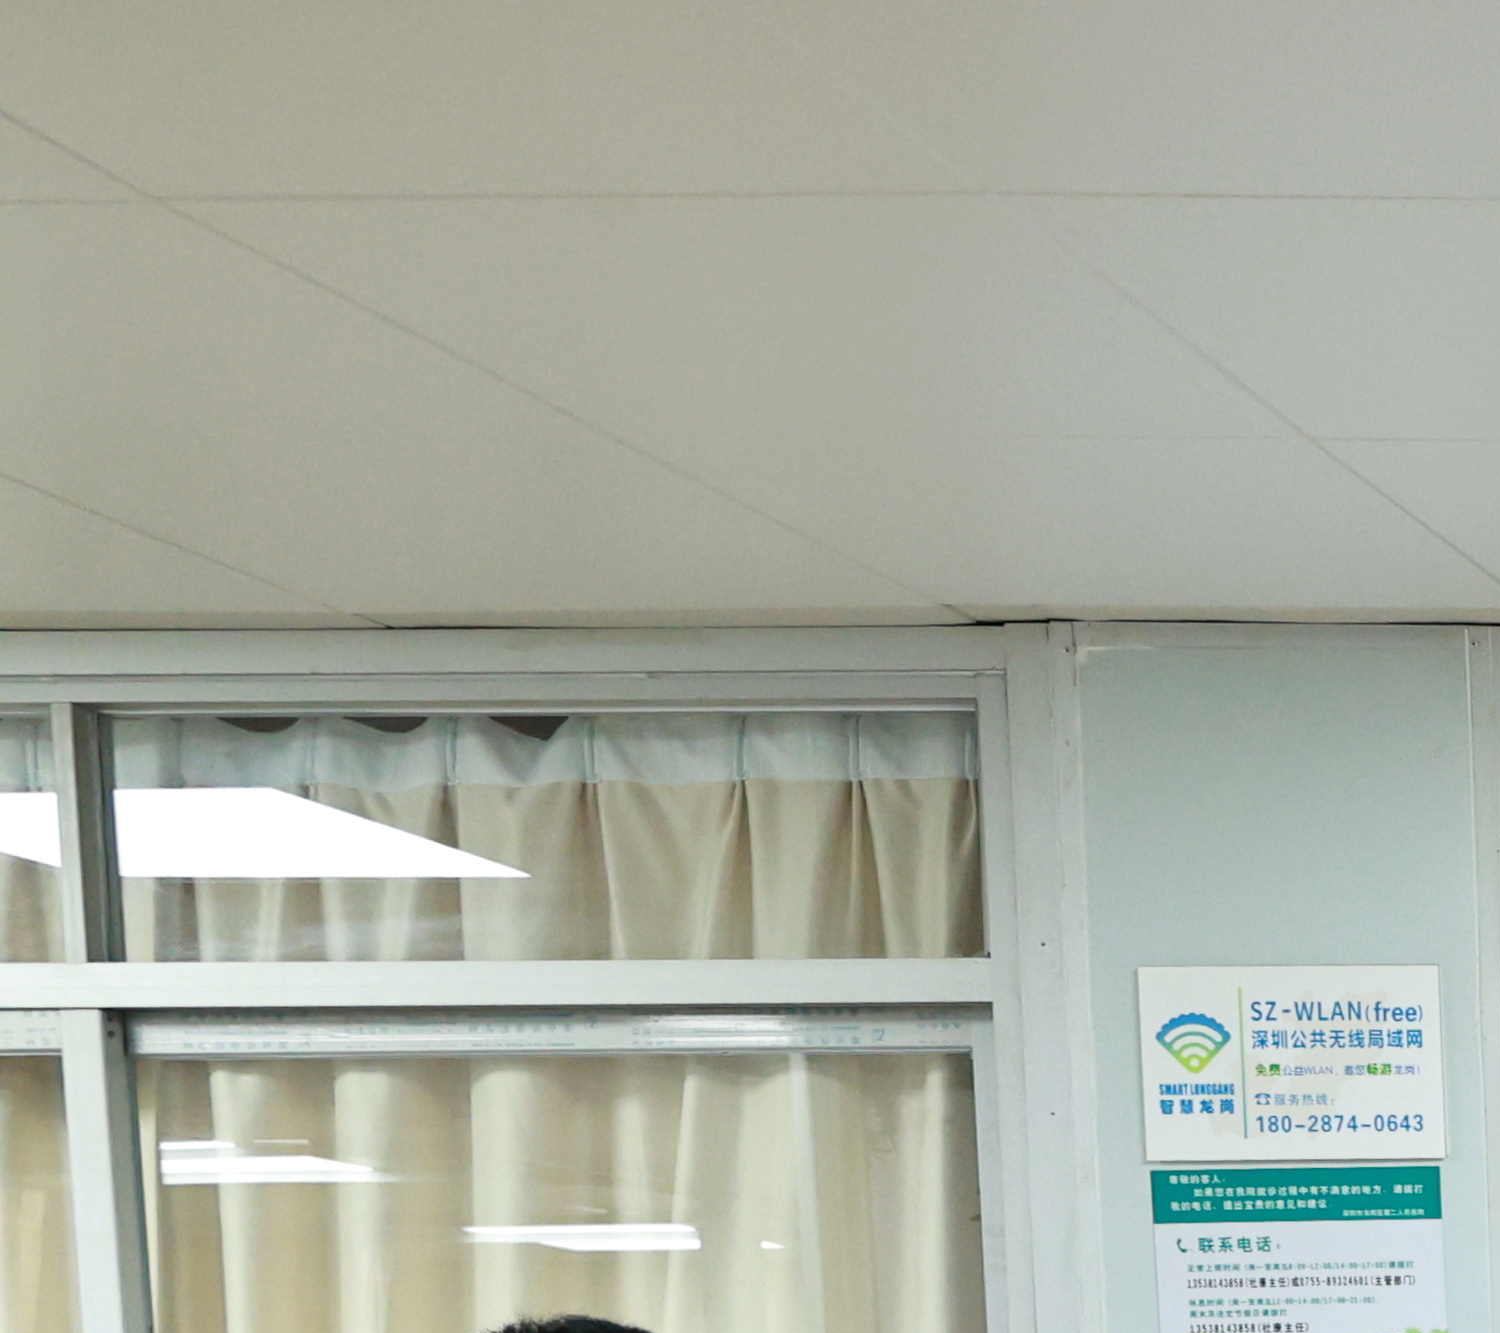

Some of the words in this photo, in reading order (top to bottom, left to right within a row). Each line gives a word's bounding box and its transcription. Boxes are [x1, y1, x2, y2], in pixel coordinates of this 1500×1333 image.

[1251, 1028, 1424, 1050] 深圳公共无线局域网
[1159, 1083, 1188, 1096] SMART
[1190, 1083, 1235, 1096] LONGGANG
[1160, 1099, 1235, 1115] 智慧龙岗
[1255, 1114, 1425, 1133] 180-2874-0643
